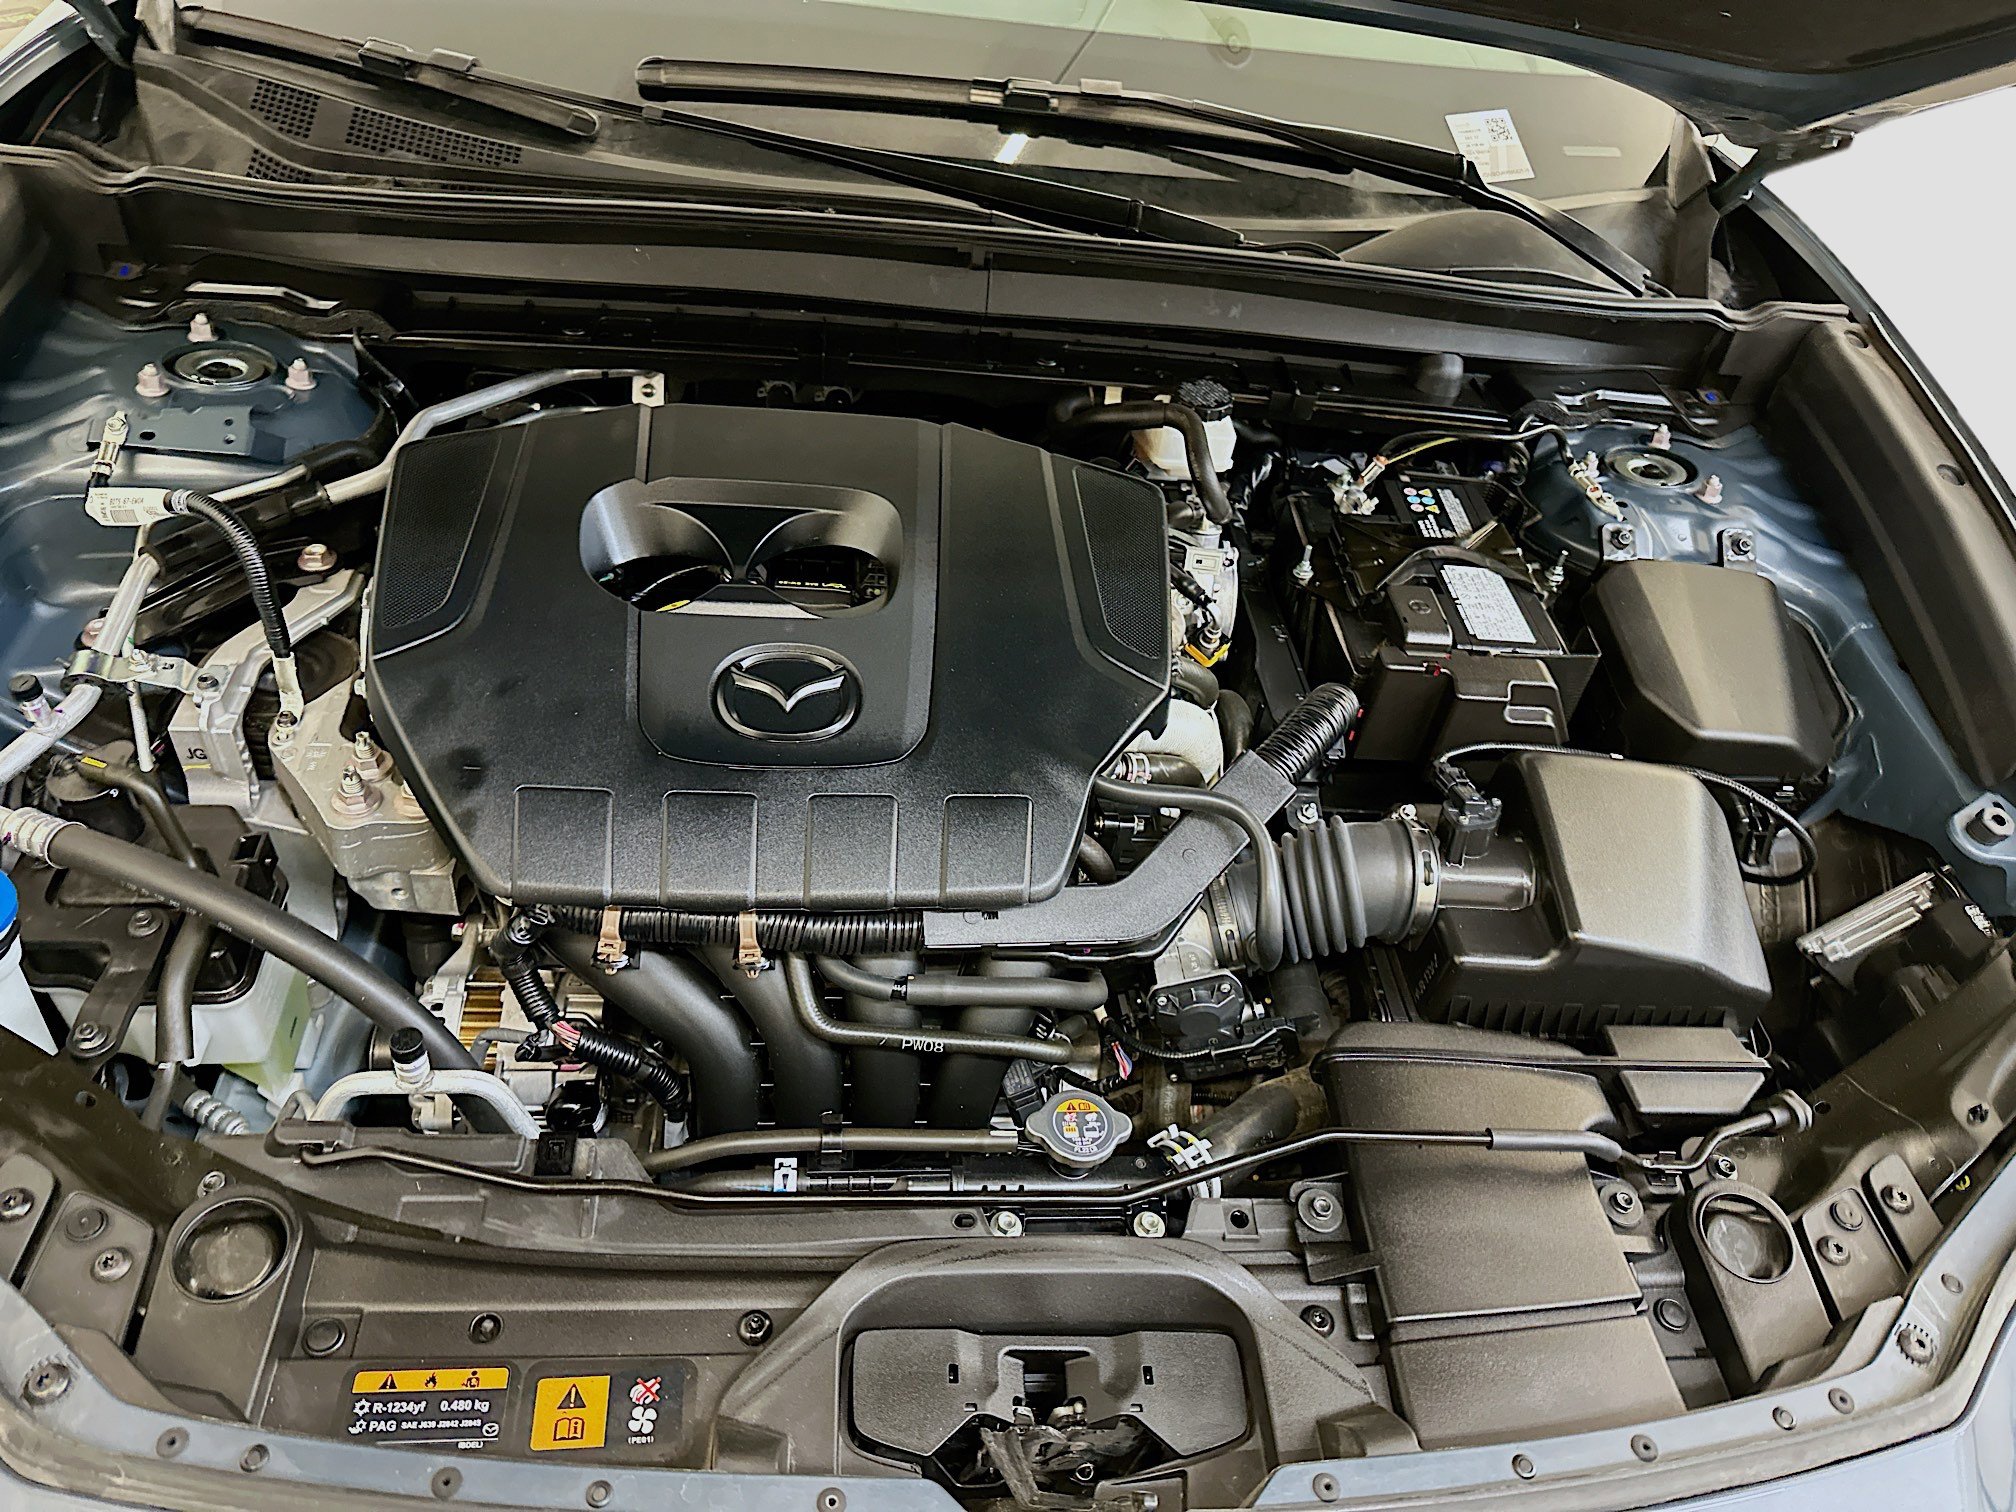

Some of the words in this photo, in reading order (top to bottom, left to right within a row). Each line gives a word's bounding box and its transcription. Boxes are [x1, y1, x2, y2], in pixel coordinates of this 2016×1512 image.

[187, 748, 207, 760] JG
[901, 1038, 944, 1053] PW08
[372, 1400, 427, 1415] R-1234yf
[440, 1400, 472, 1412] 0.480
[474, 1399, 490, 1413] kg
[368, 1420, 397, 1432] PAG
[400, 1421, 418, 1429] SAE
